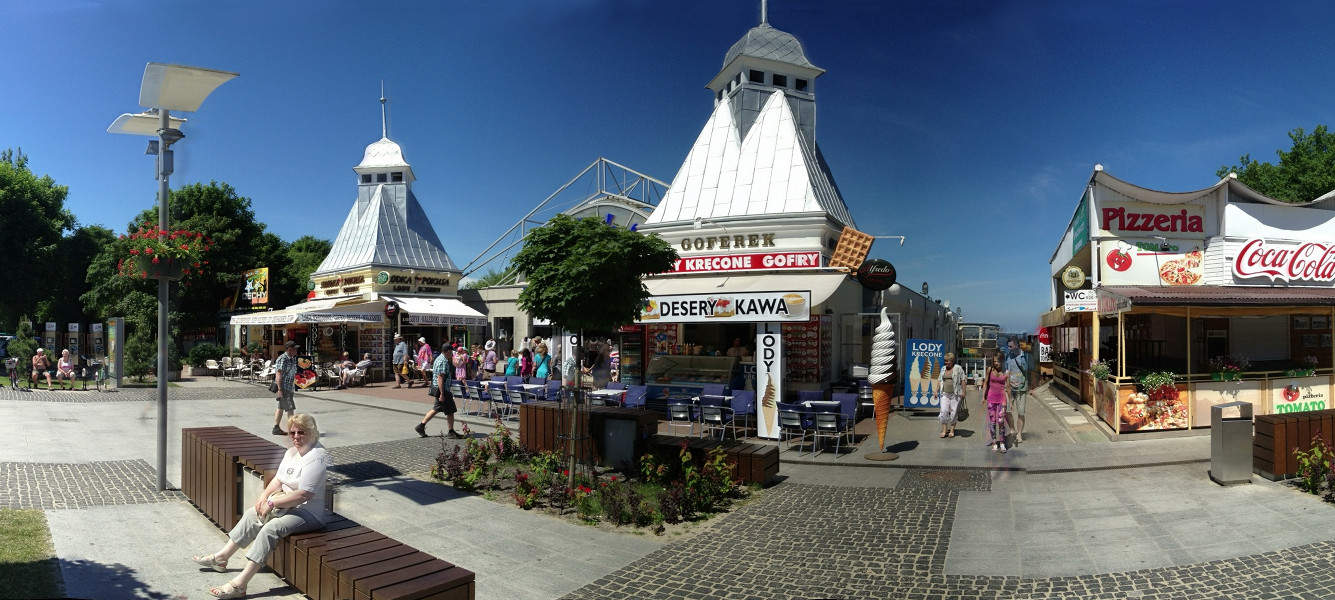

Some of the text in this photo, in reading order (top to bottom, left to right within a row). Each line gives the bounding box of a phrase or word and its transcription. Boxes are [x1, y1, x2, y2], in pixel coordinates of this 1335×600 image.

[1102, 207, 1204, 233] Pizzeria
[681, 233, 776, 250] GOFEREK
[1136, 241, 1179, 252] TOMO
[685, 255, 752, 271] KRĘCONE
[1070, 292, 1085, 300] WC
[660, 297, 789, 317] DESERY KAWA
[762, 322, 776, 373] LODY
[912, 342, 943, 352] LODY
[1276, 400, 1326, 414] TOMATO
